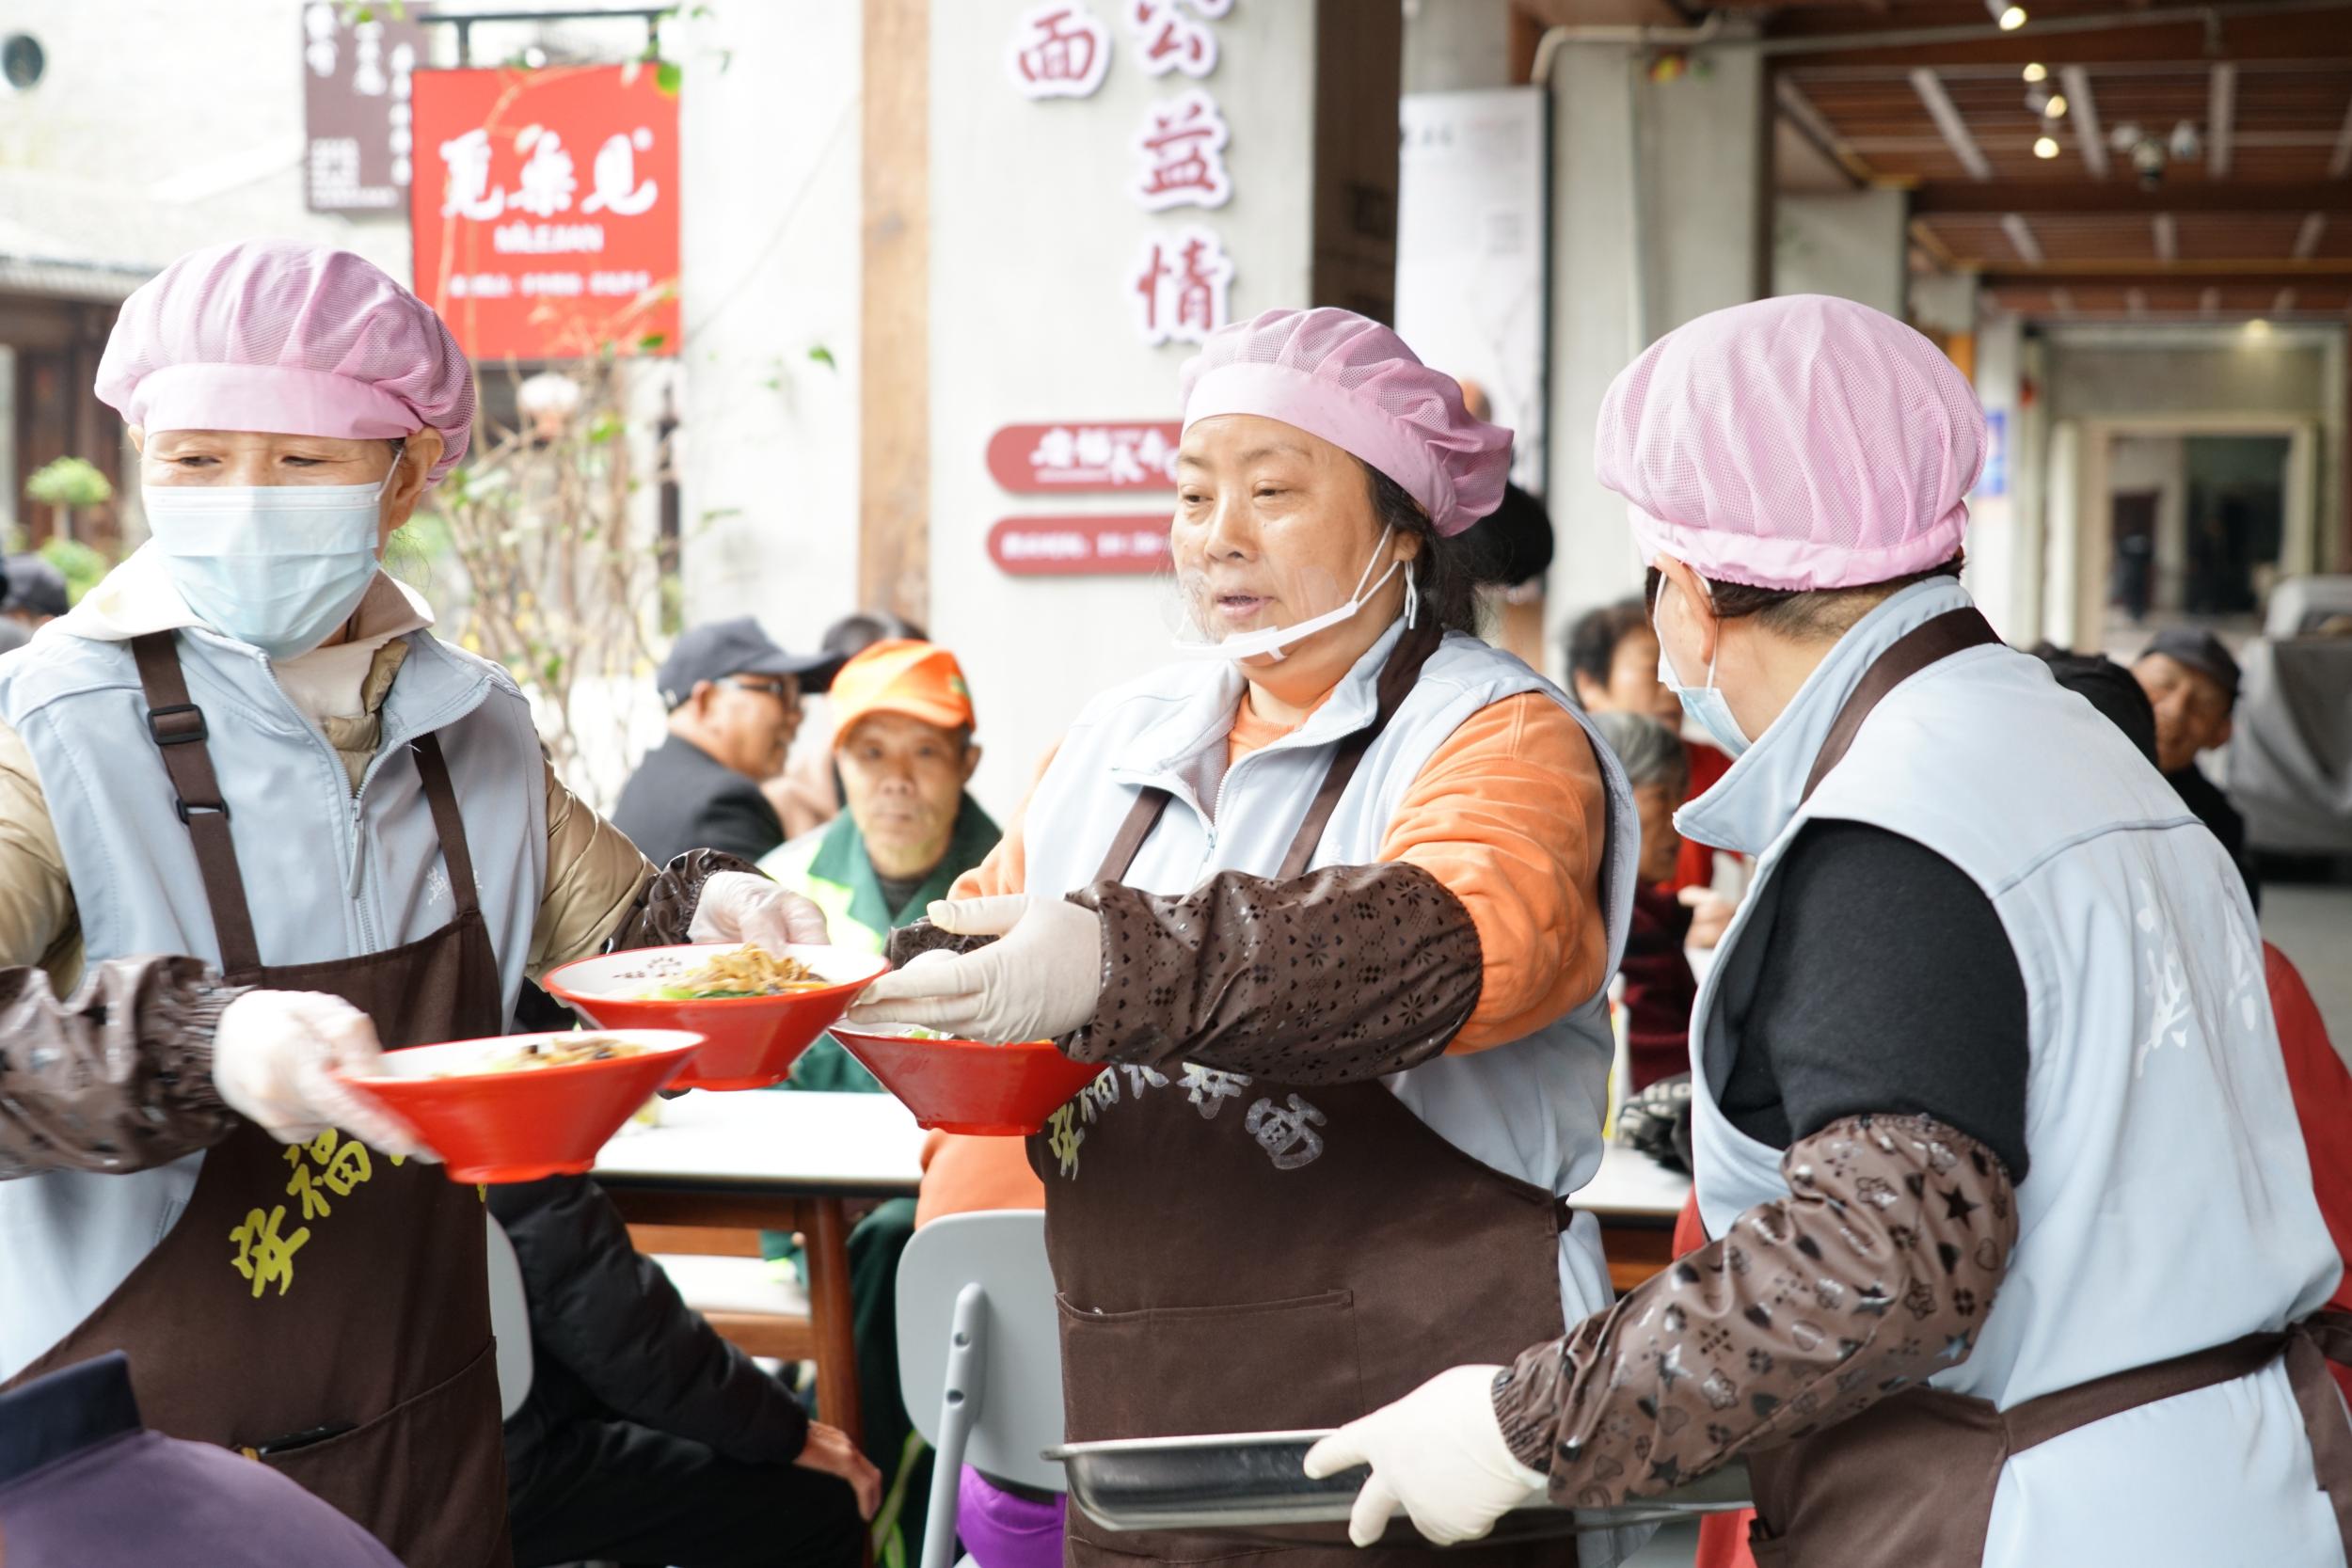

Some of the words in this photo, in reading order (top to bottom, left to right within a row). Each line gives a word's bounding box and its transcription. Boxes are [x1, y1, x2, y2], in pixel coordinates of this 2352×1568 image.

[1014, 6, 1103, 87] 面
[1131, 0, 1227, 336] 公益情
